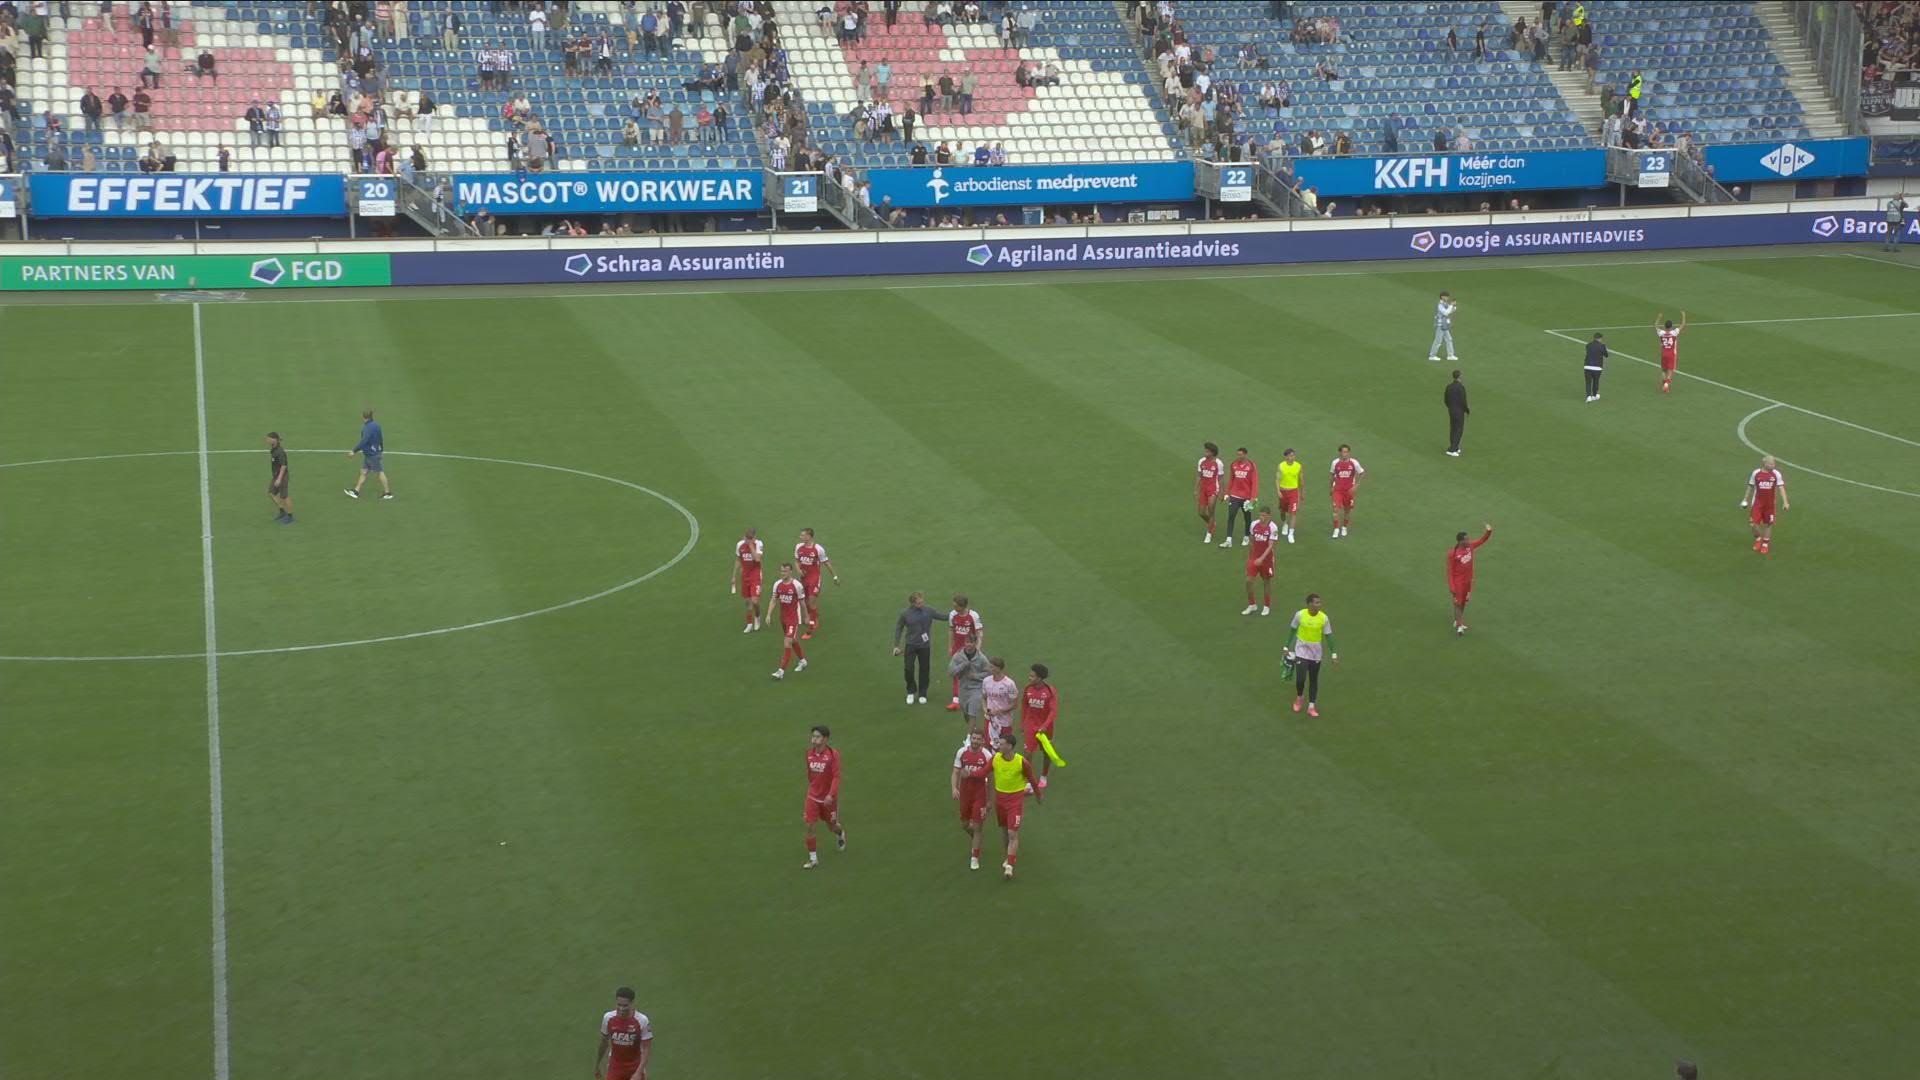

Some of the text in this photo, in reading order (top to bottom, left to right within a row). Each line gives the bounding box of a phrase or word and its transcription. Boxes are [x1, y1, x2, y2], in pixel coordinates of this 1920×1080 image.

[1459, 156, 1525, 170] Méér dan
[1646, 156, 1665, 170] 23
[953, 173, 1138, 193] arbodienst medprevent
[1227, 170, 1246, 185] 22
[1458, 173, 1516, 187] kozijnen.
[67, 178, 311, 212] EFFEKTIEF
[364, 183, 389, 198] 20
[596, 179, 752, 203] WORKWEAR
[791, 180, 809, 195] 21
[1842, 218, 1898, 234] Baro
[1439, 228, 1645, 252] Doosje ASSURANTIEADVIES
[596, 252, 785, 273] Schraa Assurantiën
[997, 240, 1240, 267] Agriland Assurantieadvies
[22, 263, 176, 281] PARTNERS VAN
[291, 260, 343, 281] FGD
